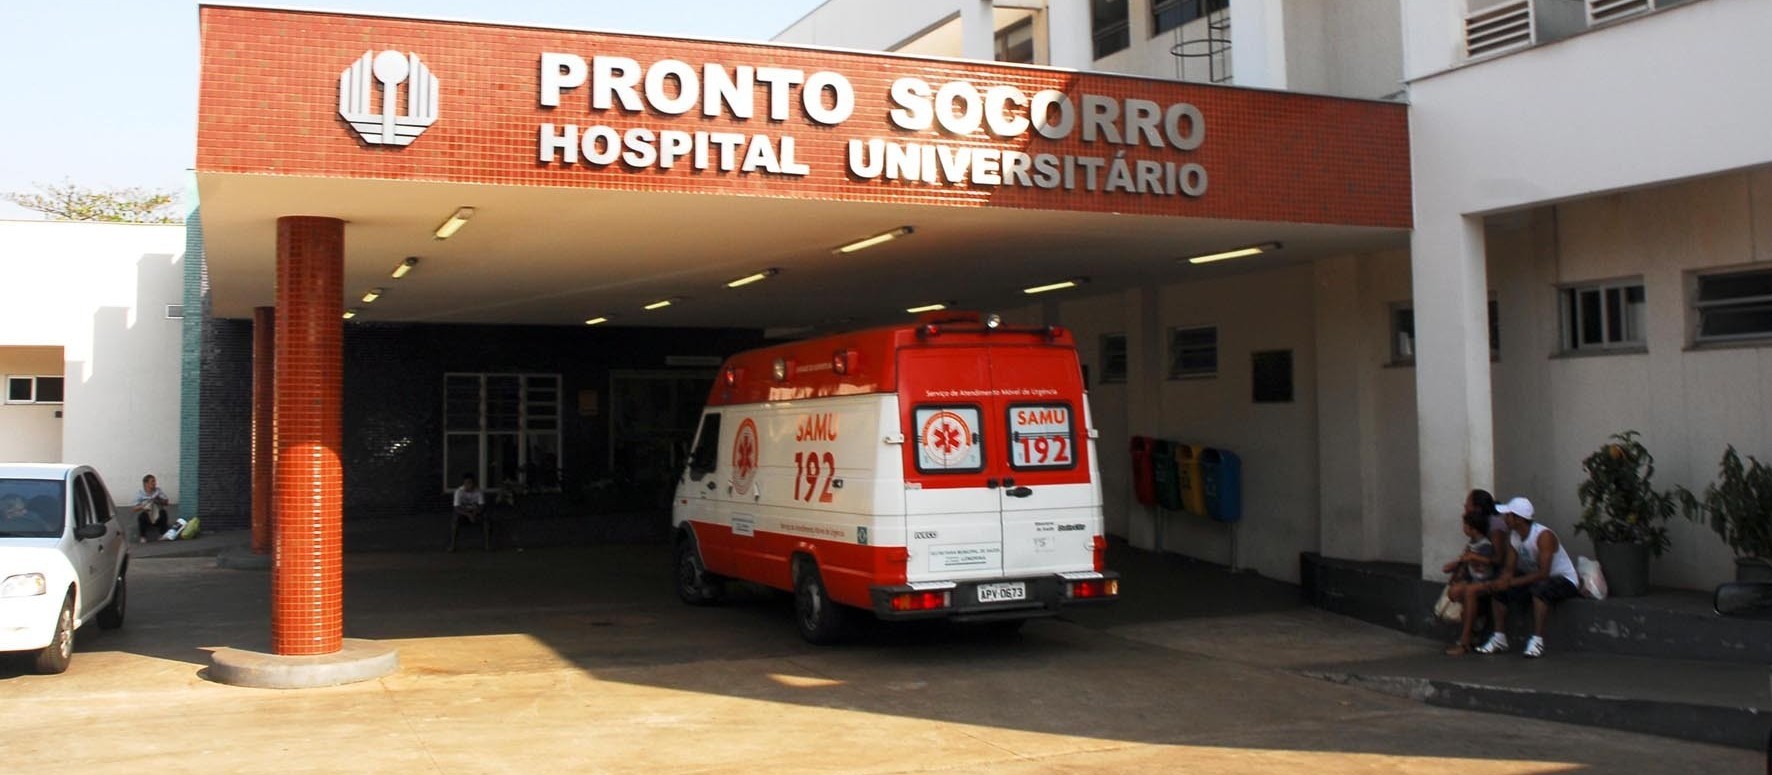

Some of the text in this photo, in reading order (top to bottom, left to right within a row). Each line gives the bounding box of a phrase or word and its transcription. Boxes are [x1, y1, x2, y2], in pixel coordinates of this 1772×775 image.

[540, 52, 1205, 150] PRONTO SOCORRO
[540, 123, 1208, 196] HOSPITAL UNIVERSITÁRIO
[926, 389, 949, 398] Serviço
[960, 388, 1000, 397] Atendimento
[795, 412, 839, 442] SAMU
[1017, 410, 1066, 426] SAMU
[1019, 435, 1069, 464] 192
[794, 451, 836, 503] 192
